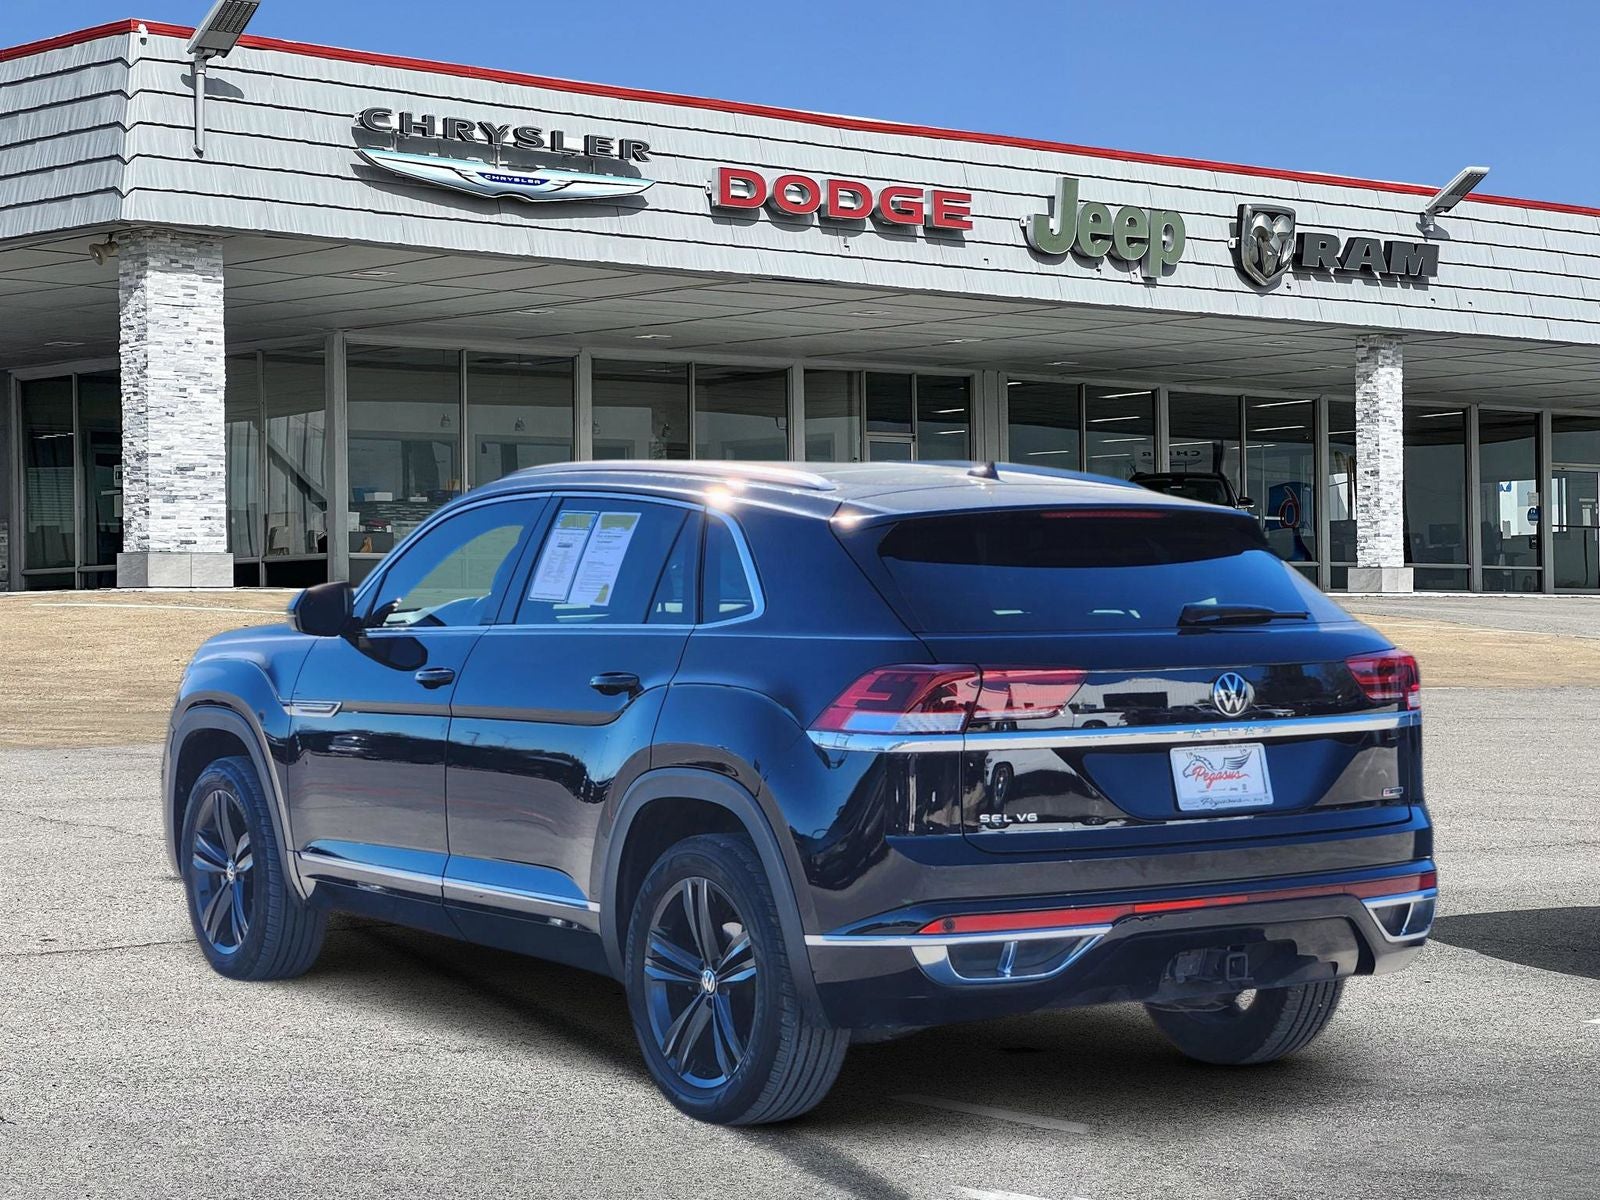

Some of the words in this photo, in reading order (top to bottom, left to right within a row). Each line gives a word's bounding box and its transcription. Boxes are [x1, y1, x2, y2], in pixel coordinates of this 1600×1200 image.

[357, 107, 651, 162] CHRYSLER
[484, 174, 541, 185] CHRYSLER
[711, 166, 974, 231] DODGE
[1027, 177, 1187, 279] Jeep
[1299, 231, 1441, 277] RAM
[1191, 765, 1250, 790] Pegasus
[979, 813, 1013, 823] SEL
[1016, 812, 1038, 822] V6
